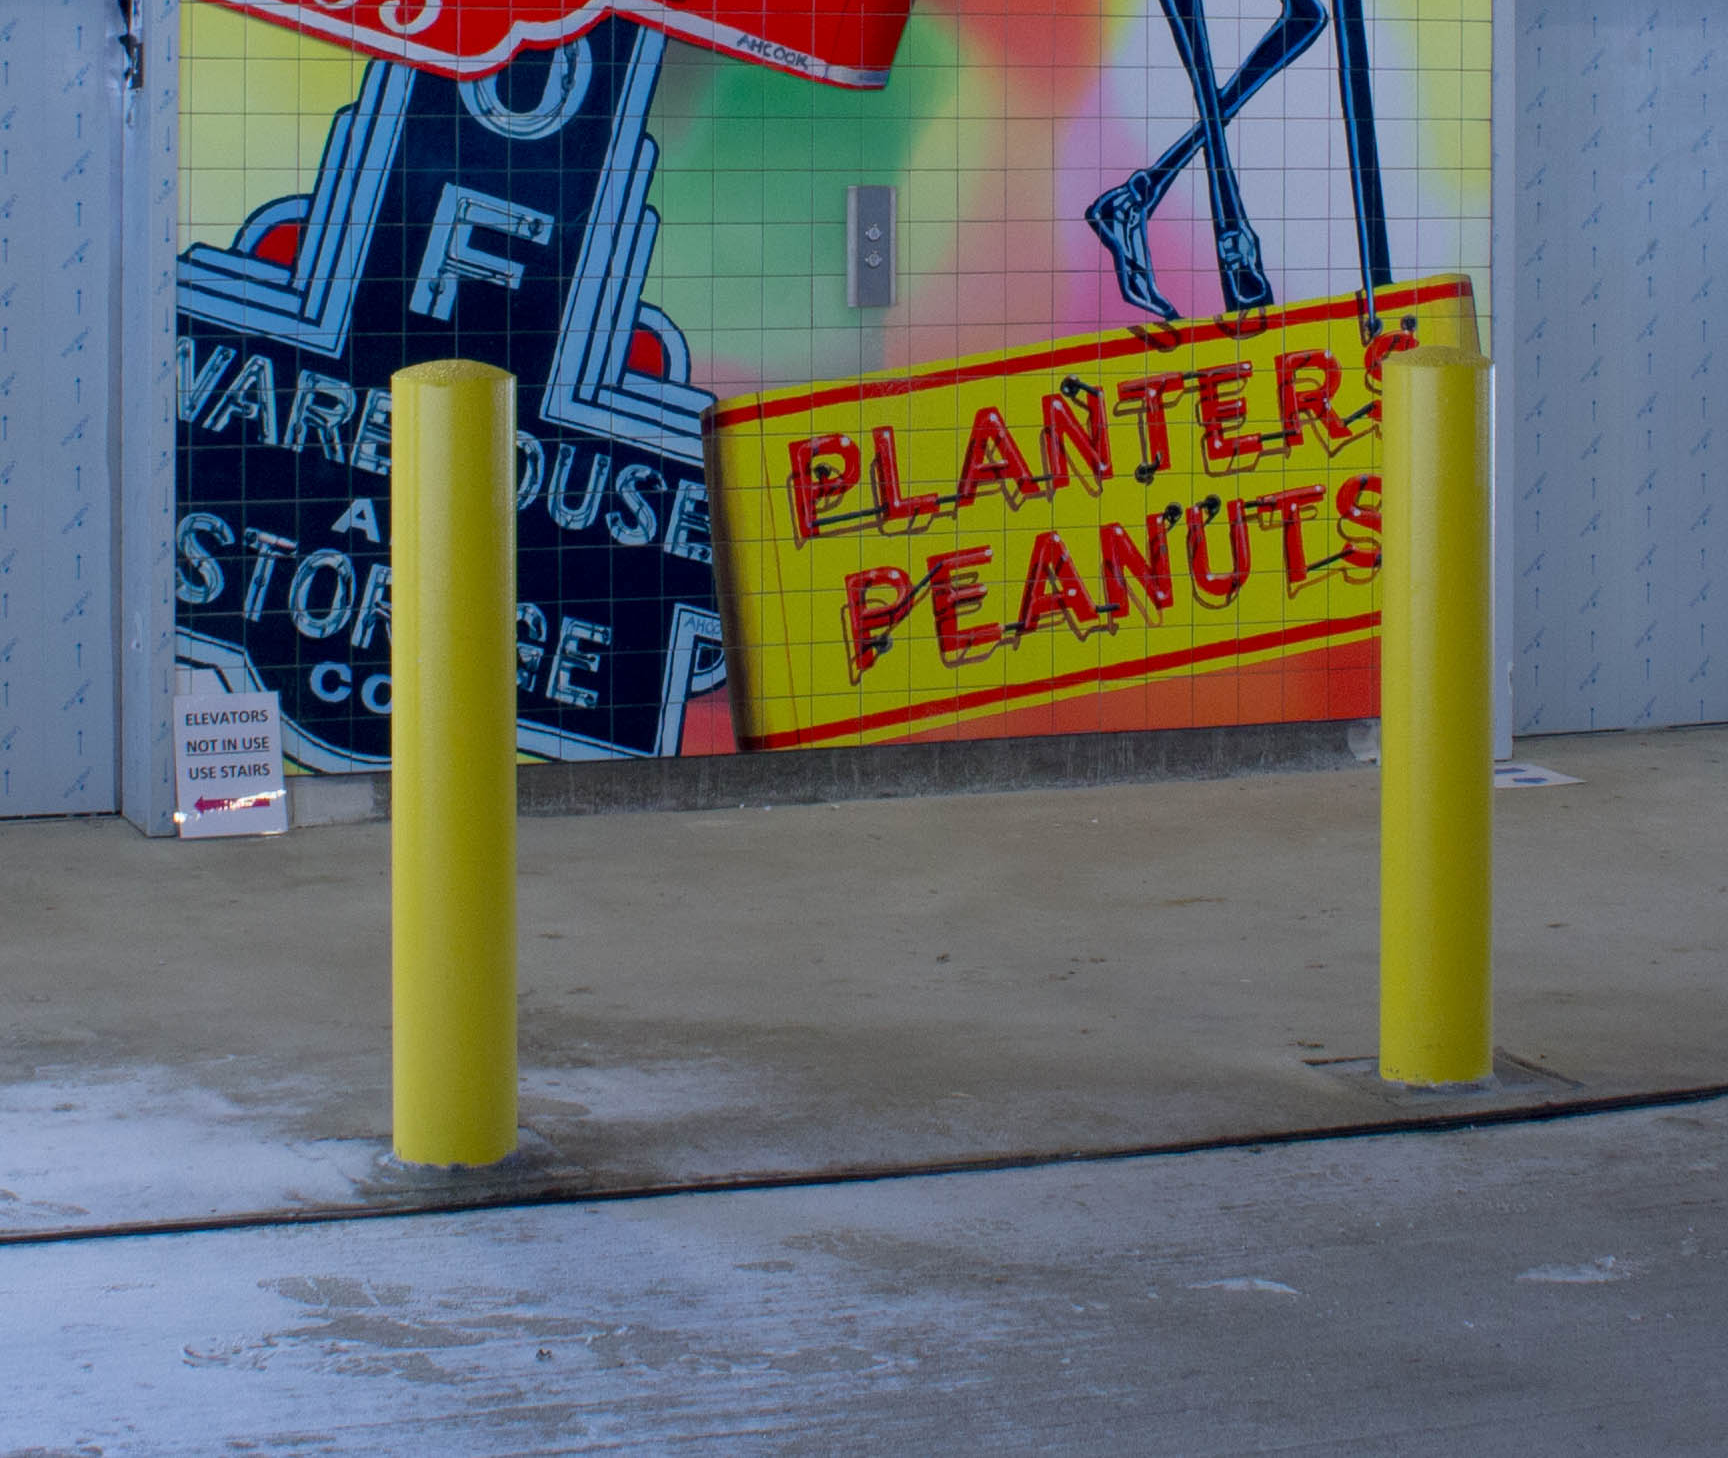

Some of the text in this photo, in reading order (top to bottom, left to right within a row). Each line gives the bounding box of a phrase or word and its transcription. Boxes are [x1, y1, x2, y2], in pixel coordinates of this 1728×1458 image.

[185, 709, 270, 727] ELEVATORS
[186, 736, 270, 753] NOT IN USE
[189, 763, 271, 780] USE STAIRS
